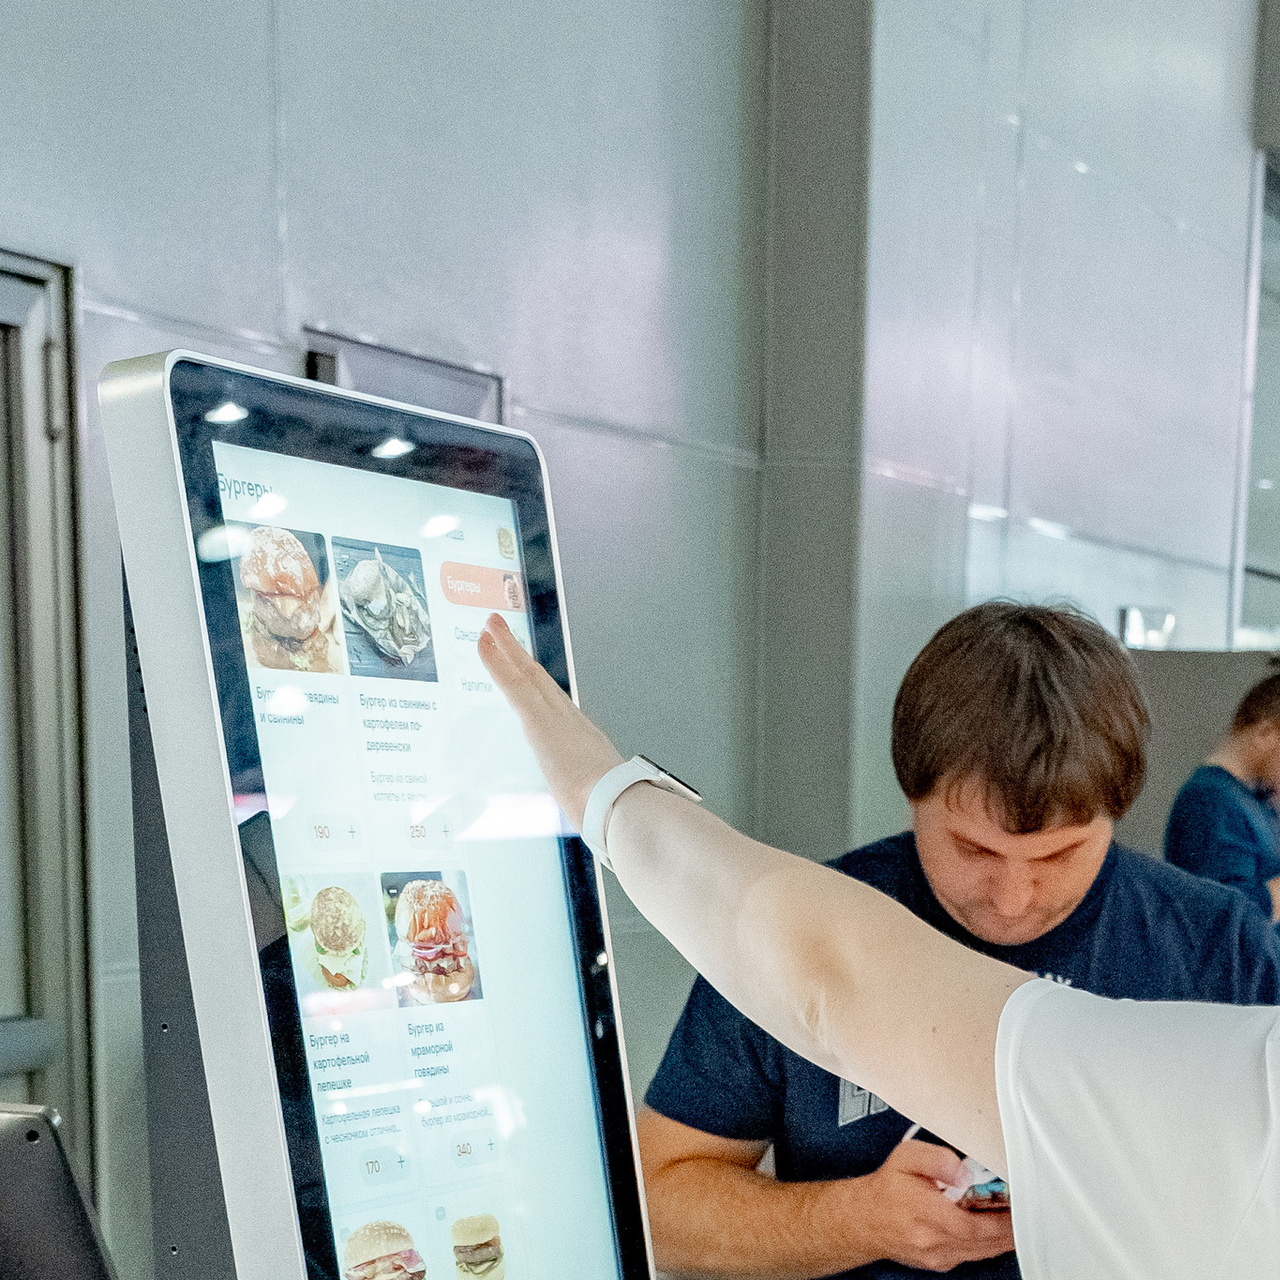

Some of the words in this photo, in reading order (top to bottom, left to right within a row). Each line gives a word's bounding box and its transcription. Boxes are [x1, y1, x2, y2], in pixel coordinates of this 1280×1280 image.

[447, 575, 481, 598] Бургеры
[461, 677, 492, 693] Напитки
[360, 694, 387, 710] Бургер
[388, 698, 398, 708] из
[399, 700, 430, 710] свинины
[432, 701, 437, 710] с
[363, 718, 409, 732] картофелем
[410, 722, 422, 731] по-
[366, 741, 411, 754] деревенски
[314, 826, 330, 839] 190
[410, 825, 426, 838] 250
[408, 1023, 434, 1038] Бургер
[436, 1022, 444, 1032] из
[309, 1034, 338, 1049] Бургер
[340, 1033, 350, 1044] на
[411, 1040, 453, 1060] мраморной
[313, 1052, 370, 1072] картофельной
[414, 1065, 450, 1078] говядины
[317, 1078, 352, 1092] лепешке
[321, 1110, 370, 1127] Картофельная
[372, 1105, 400, 1117] лепешка
[457, 1142, 472, 1156] 340
[366, 1160, 380, 1174] 170
